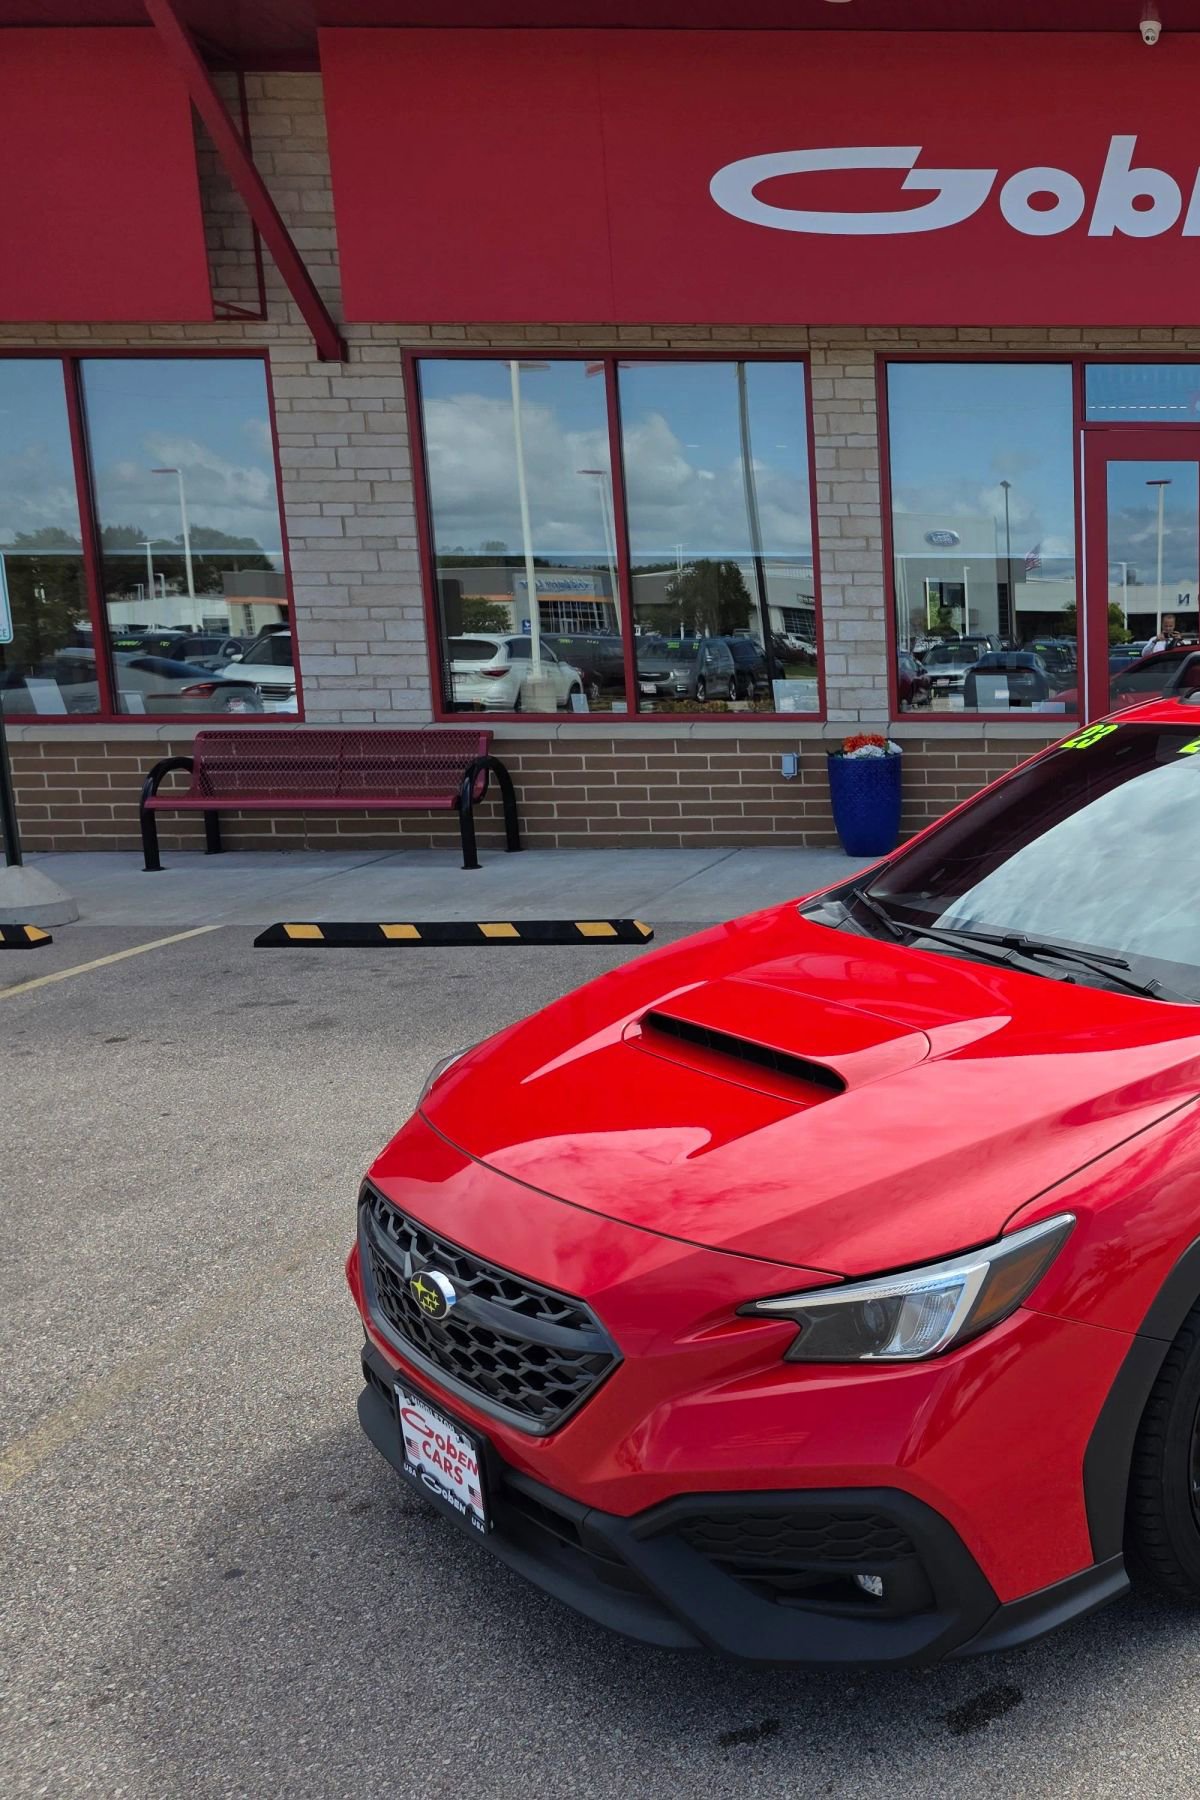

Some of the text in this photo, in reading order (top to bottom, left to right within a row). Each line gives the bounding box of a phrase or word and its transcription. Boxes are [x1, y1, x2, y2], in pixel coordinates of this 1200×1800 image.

[1060, 724, 1119, 749] 23
[403, 1462, 417, 1478] USA
[422, 1440, 463, 1486] CARS
[471, 1516, 485, 1534] USA
